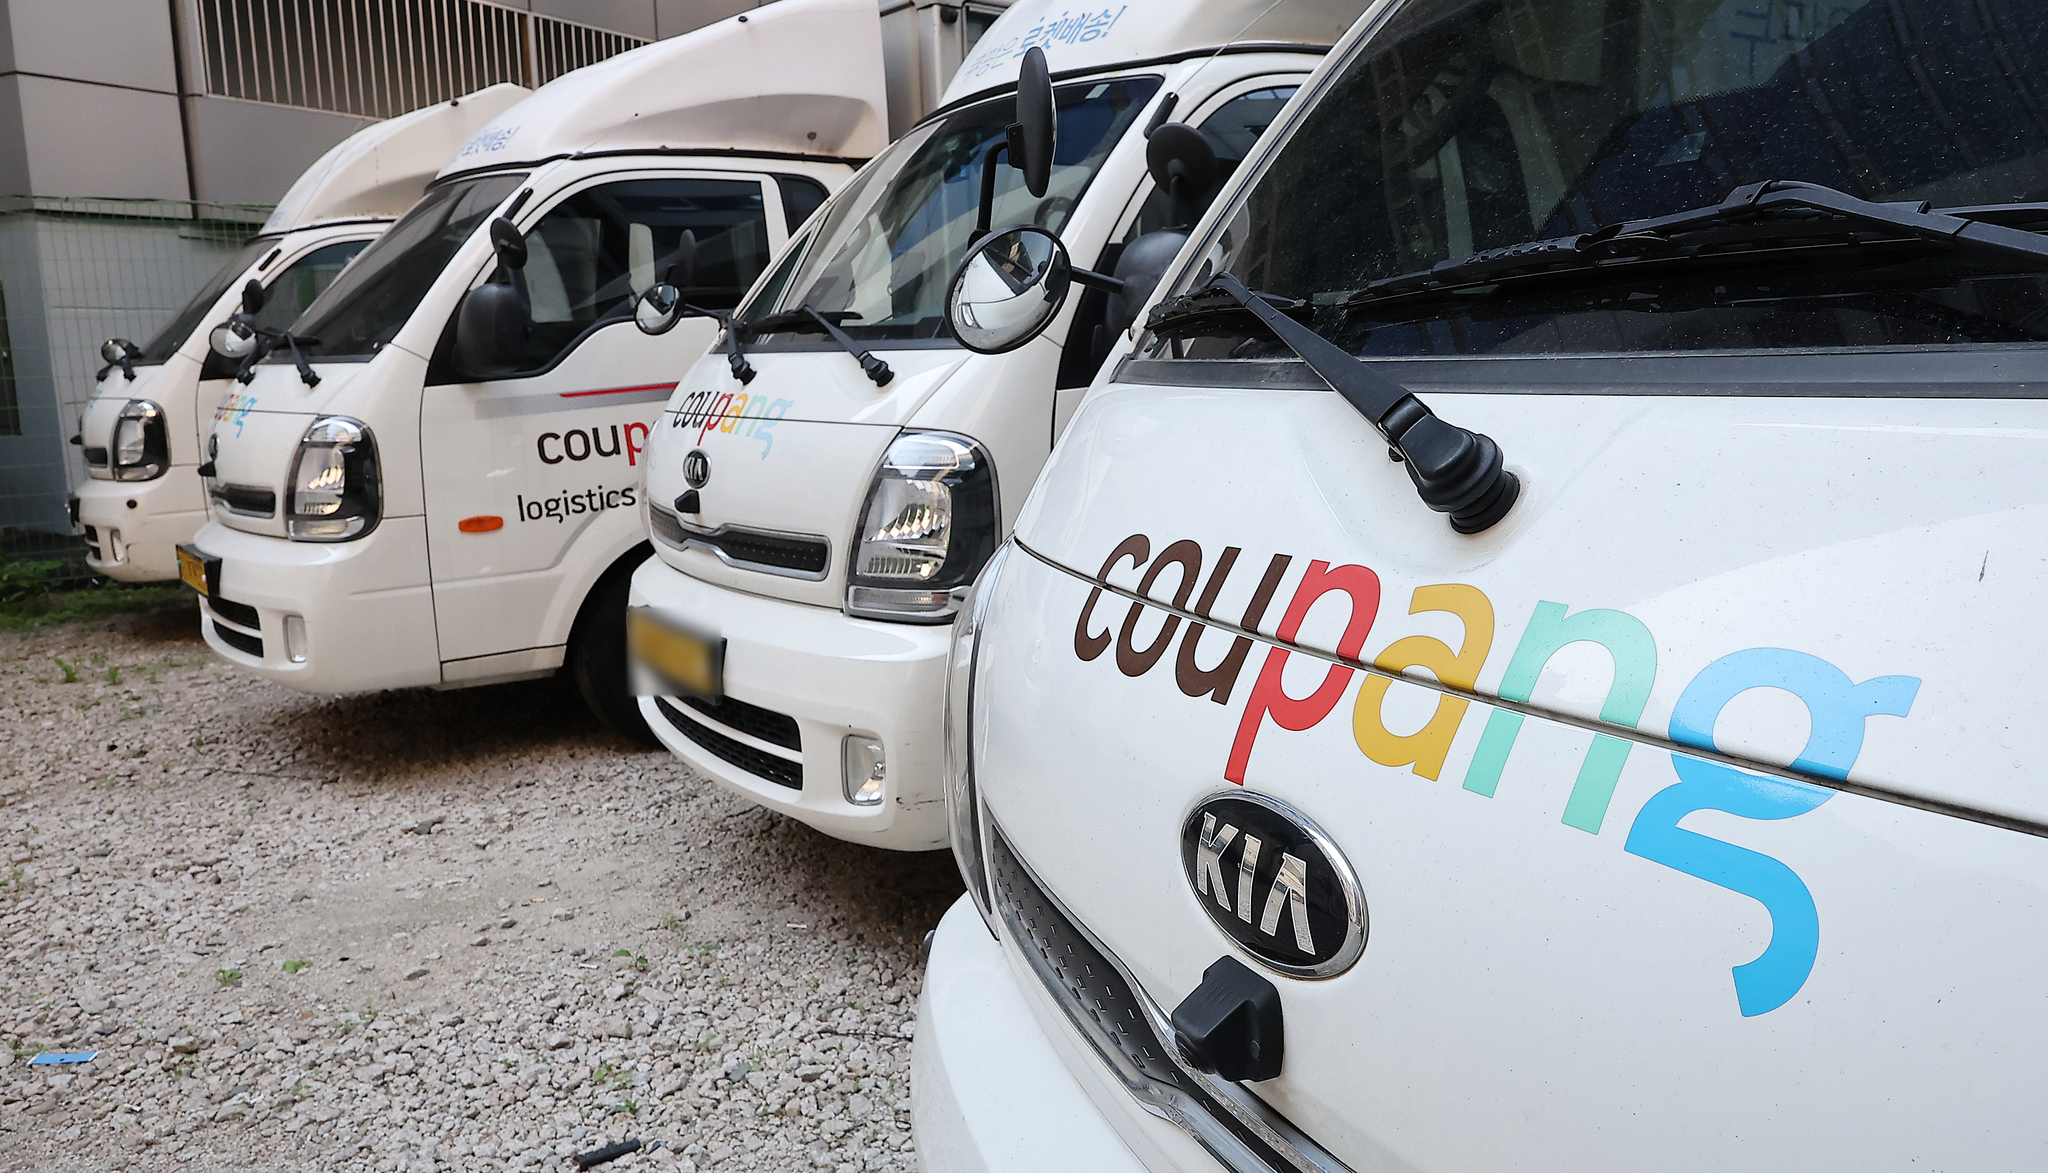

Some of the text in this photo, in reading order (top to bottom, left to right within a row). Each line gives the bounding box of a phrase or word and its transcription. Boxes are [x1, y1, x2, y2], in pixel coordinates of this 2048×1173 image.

[537, 422, 653, 465] coup
[673, 391, 794, 460] coupang
[517, 485, 636, 524] logistics
[1075, 534, 1921, 1018] coupang
[1196, 811, 1316, 957] KIA
